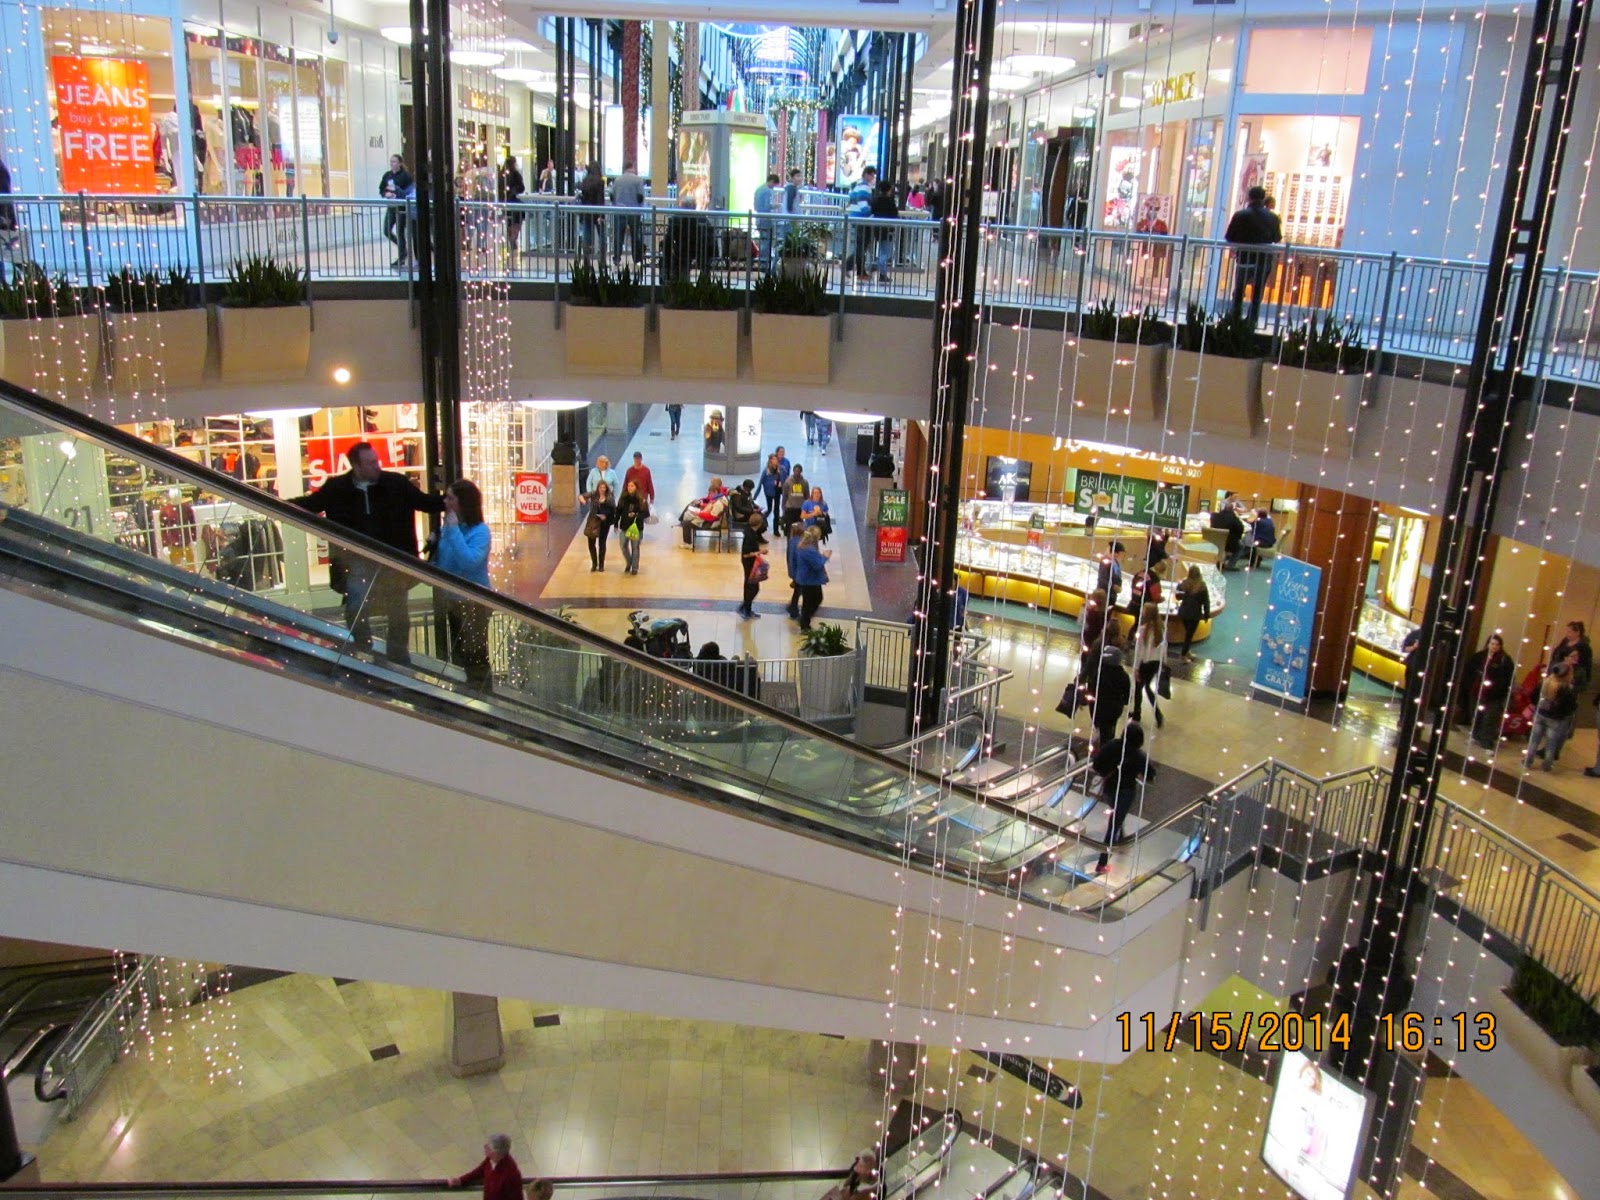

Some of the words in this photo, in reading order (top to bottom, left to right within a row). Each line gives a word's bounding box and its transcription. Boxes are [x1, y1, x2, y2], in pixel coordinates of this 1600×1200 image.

[60, 85, 147, 109] JEANS
[69, 112, 92, 126] buy
[109, 115, 129, 127] get
[64, 131, 151, 162] FREE
[308, 437, 405, 488] SAE
[520, 485, 543, 495] DEAL
[1080, 475, 1137, 494] BRILLIANT
[520, 503, 543, 511] WEEK
[883, 496, 906, 504] SALE
[1078, 487, 1135, 515] SALE
[1143, 491, 1168, 516] 20
[64, 505, 93, 534] 21
[882, 508, 896, 521] 20
[1265, 673, 1294, 689] CRAZY
[1025, 1064, 1048, 1082] Mall
